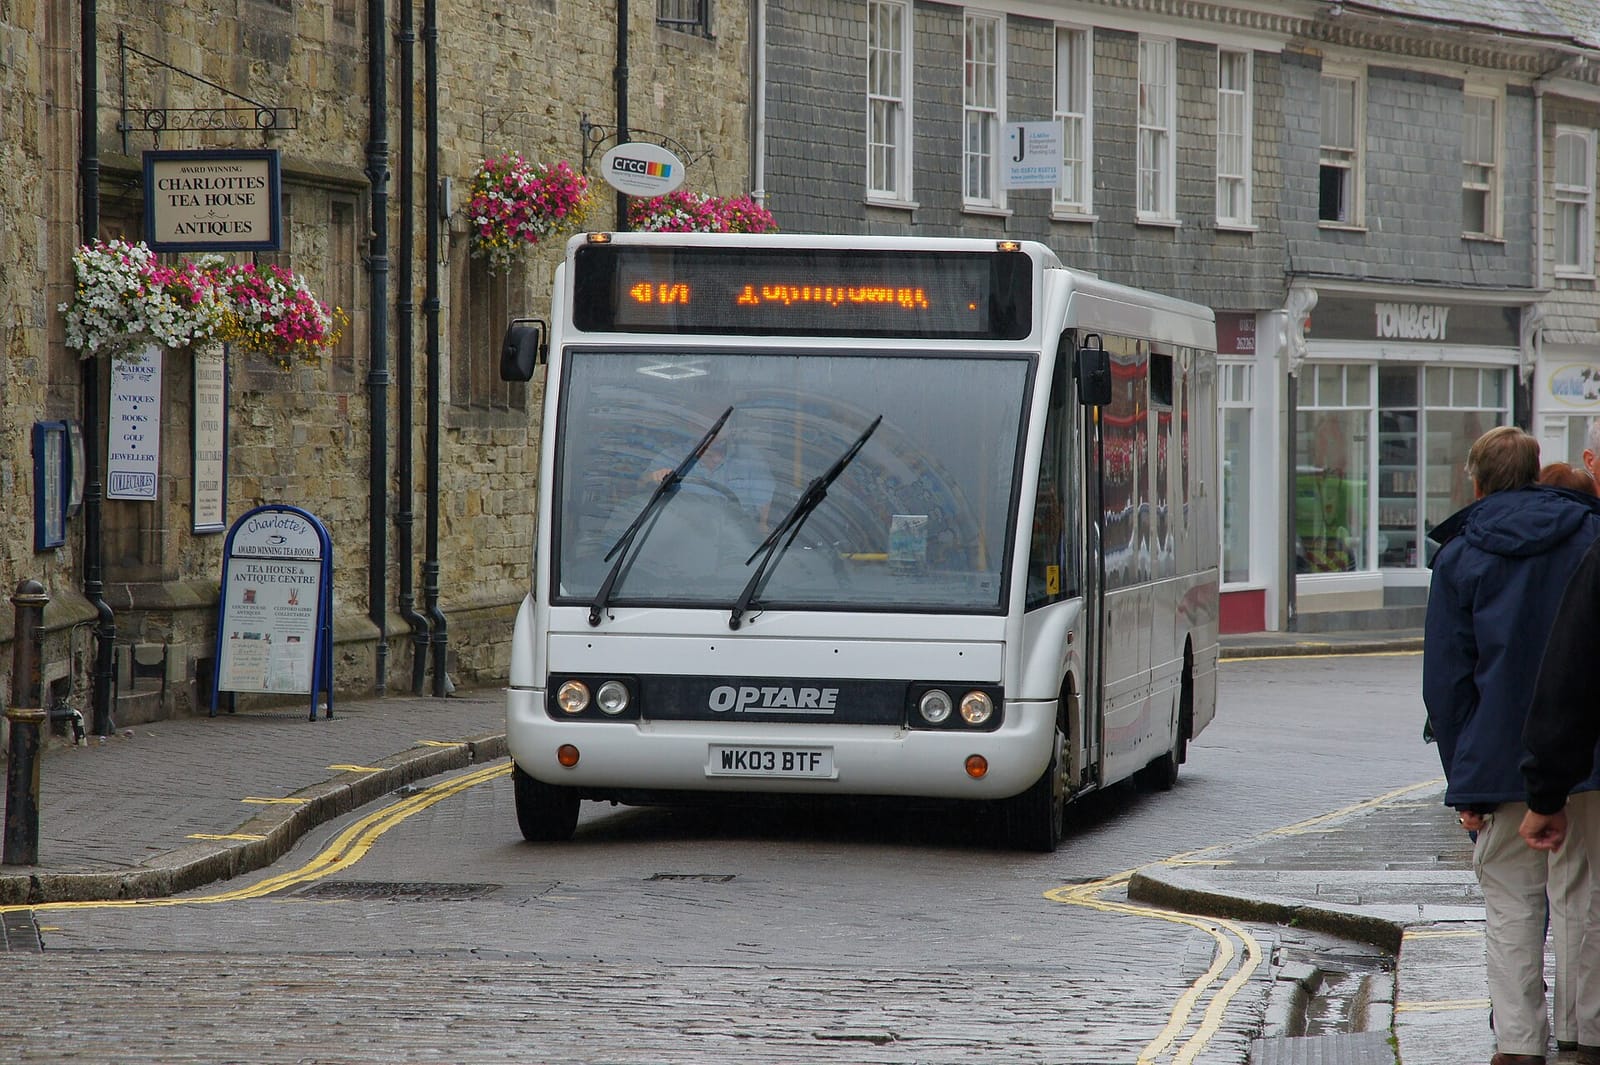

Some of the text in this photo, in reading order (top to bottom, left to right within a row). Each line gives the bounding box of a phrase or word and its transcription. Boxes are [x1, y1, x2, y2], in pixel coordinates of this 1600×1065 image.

[180, 165, 242, 174] AWARD WINNING
[614, 158, 645, 173] crcc
[158, 176, 265, 191] CHARLOTTES
[168, 193, 256, 207] TEA HOUSE
[174, 220, 253, 236] ANTIQUES
[1375, 303, 1449, 340] TONI&GUY
[118, 394, 155, 403] ANTIQUES
[122, 414, 148, 422] BOOKS
[110, 453, 155, 461] JEWELLERY
[247, 515, 308, 535] Charlotte's
[257, 546, 282, 555] WINNING
[283, 547, 294, 556] TEA
[246, 564, 263, 573] TEA
[265, 565, 298, 574] HOUSE
[234, 574, 315, 584] ANTIQUE CENTRE
[708, 686, 839, 713] OPTARE
[721, 750, 822, 771] WK03 BTF
